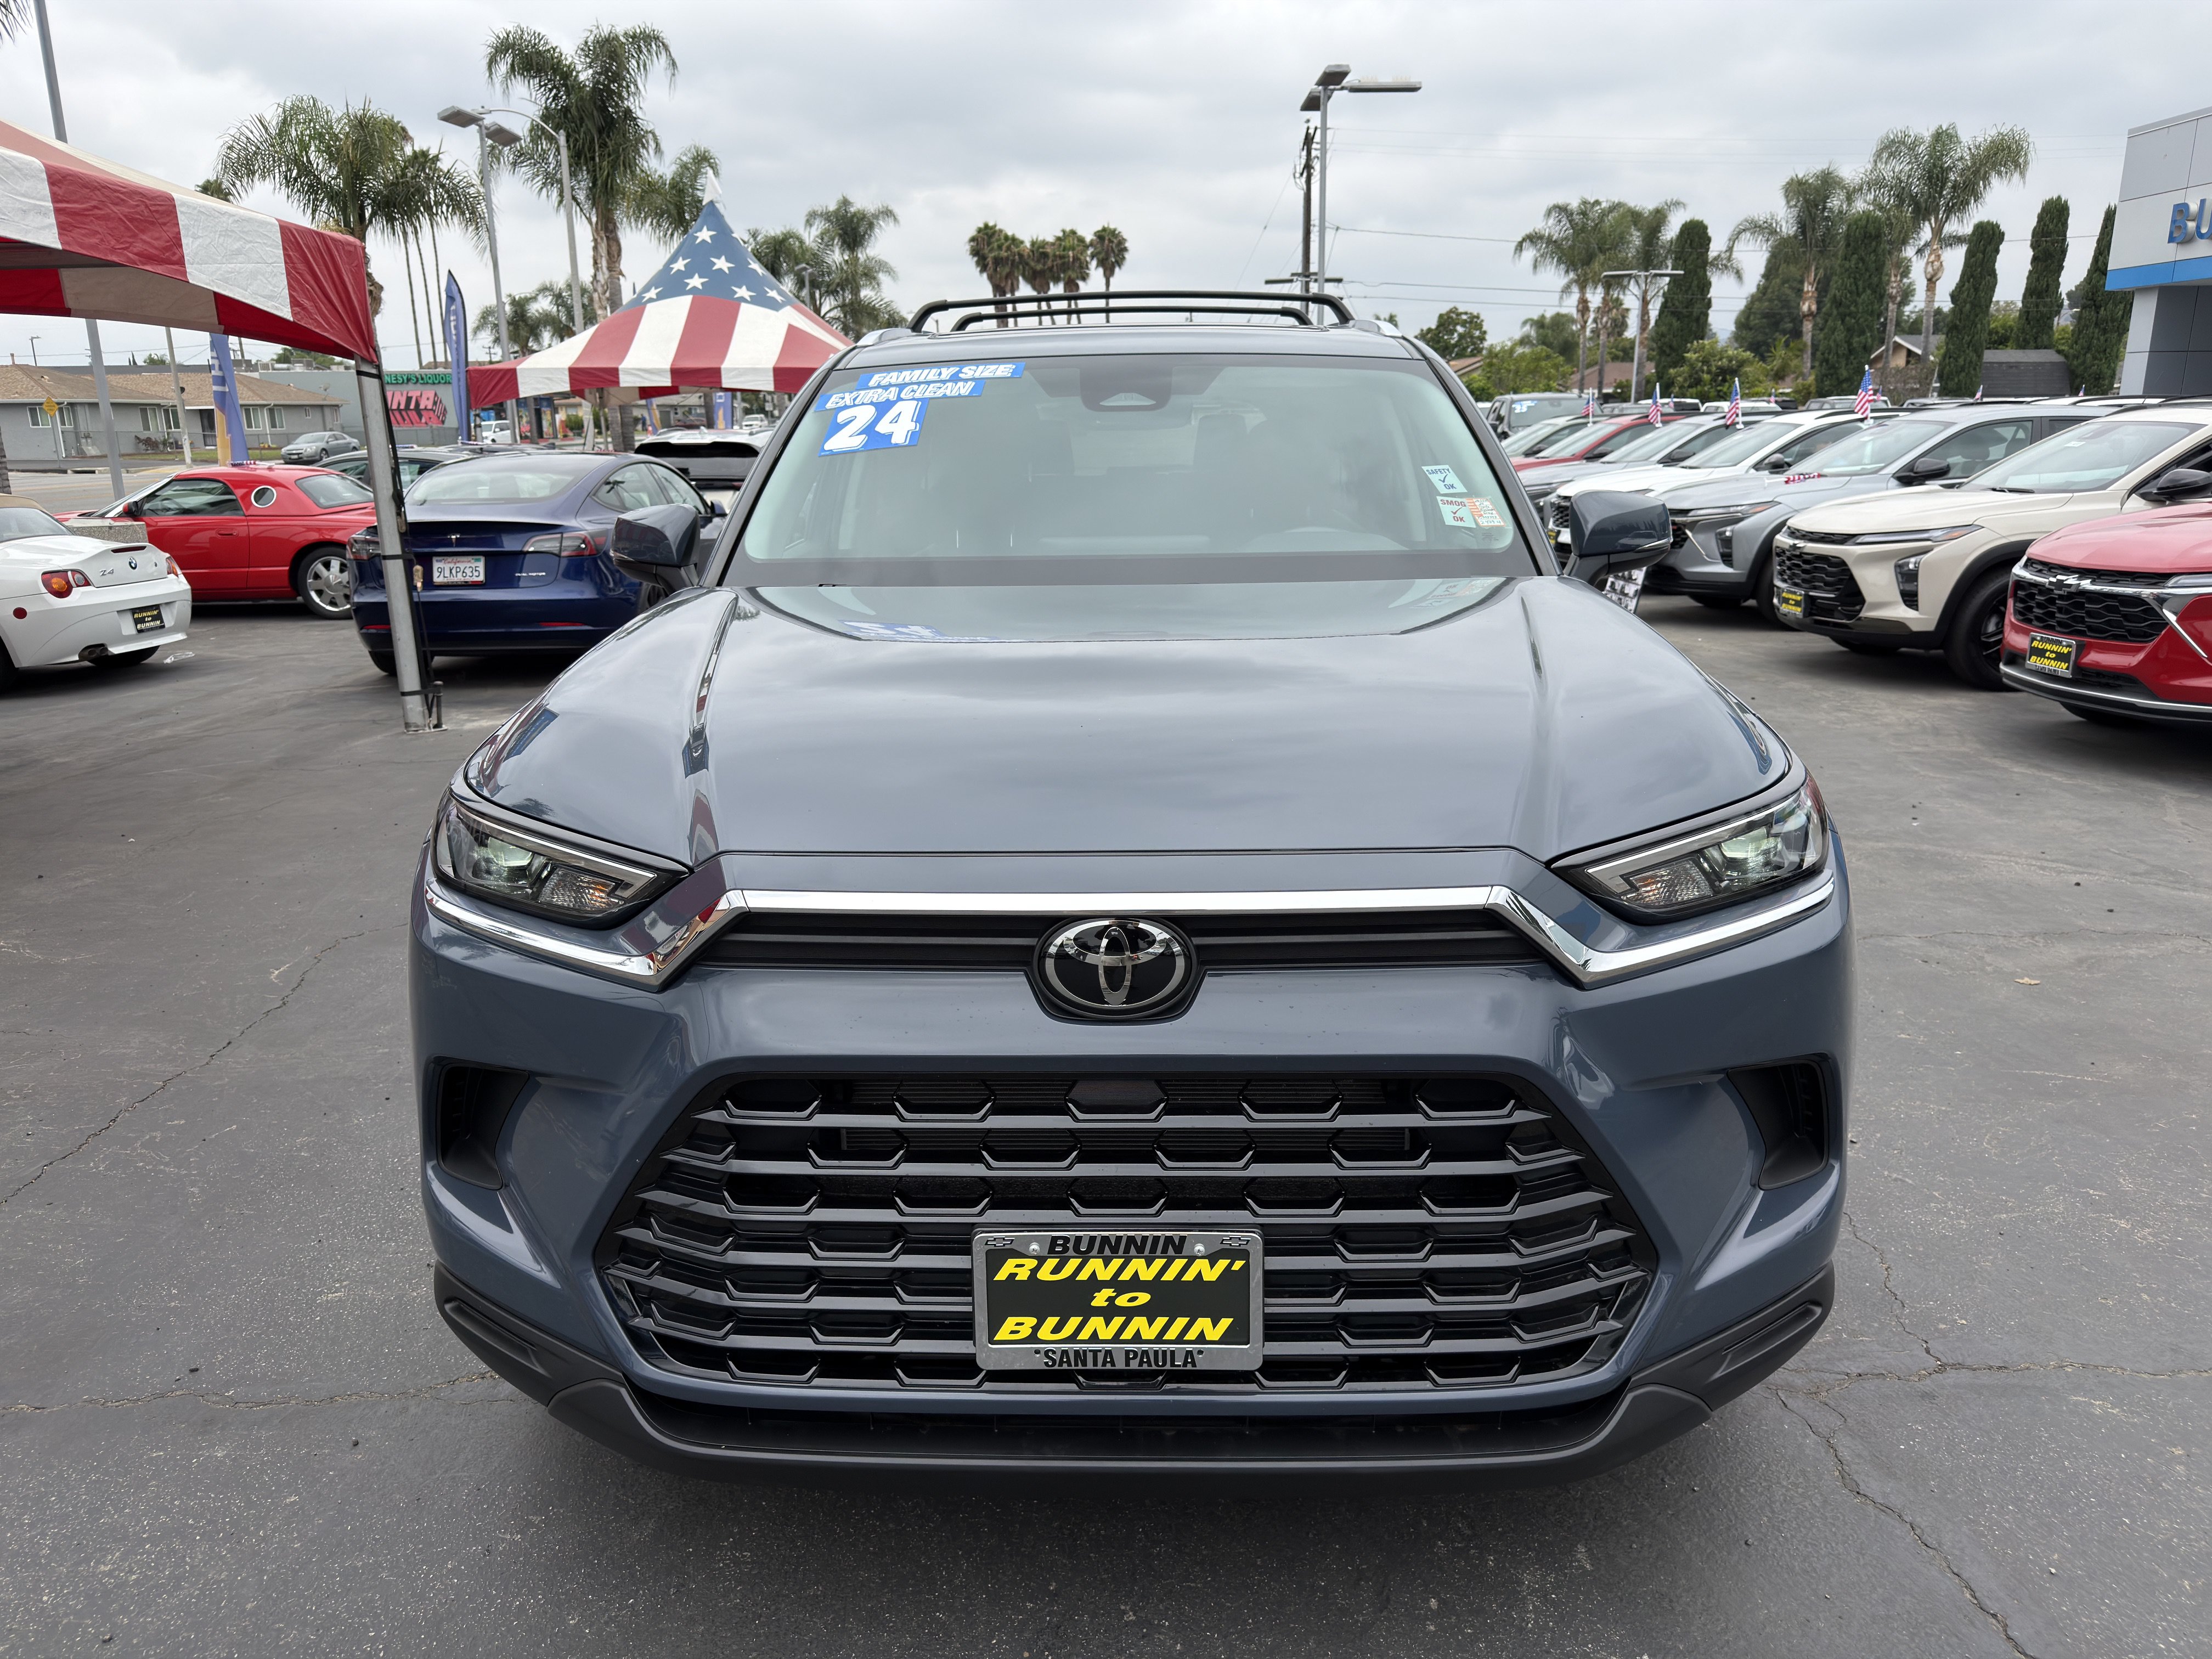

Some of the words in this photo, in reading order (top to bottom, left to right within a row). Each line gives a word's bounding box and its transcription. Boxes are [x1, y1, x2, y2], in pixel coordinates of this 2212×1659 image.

[418, 374, 452, 384] LIQUOR
[868, 366, 960, 387] FAMILY
[959, 364, 1016, 379] SIZE
[825, 386, 899, 409] EXTRA
[900, 381, 975, 399] CLEAN
[823, 400, 922, 452] 24
[1440, 499, 1466, 507] SMOG
[437, 566, 481, 579] 9LKP635
[134, 610, 159, 618] RUNNIN'
[137, 620, 161, 629] BUNNIN
[2031, 640, 2072, 654] RUNNIN'
[2030, 656, 2068, 670] BUNNIN
[1047, 1234, 1188, 1255] BUNNIN
[993, 1258, 1246, 1282] RUNNIN'
[1091, 1288, 1152, 1307] to
[993, 1316, 1234, 1341] BUNNIN
[1043, 1347, 1116, 1368] SANTA
[1124, 1347, 1198, 1368] PAULA
